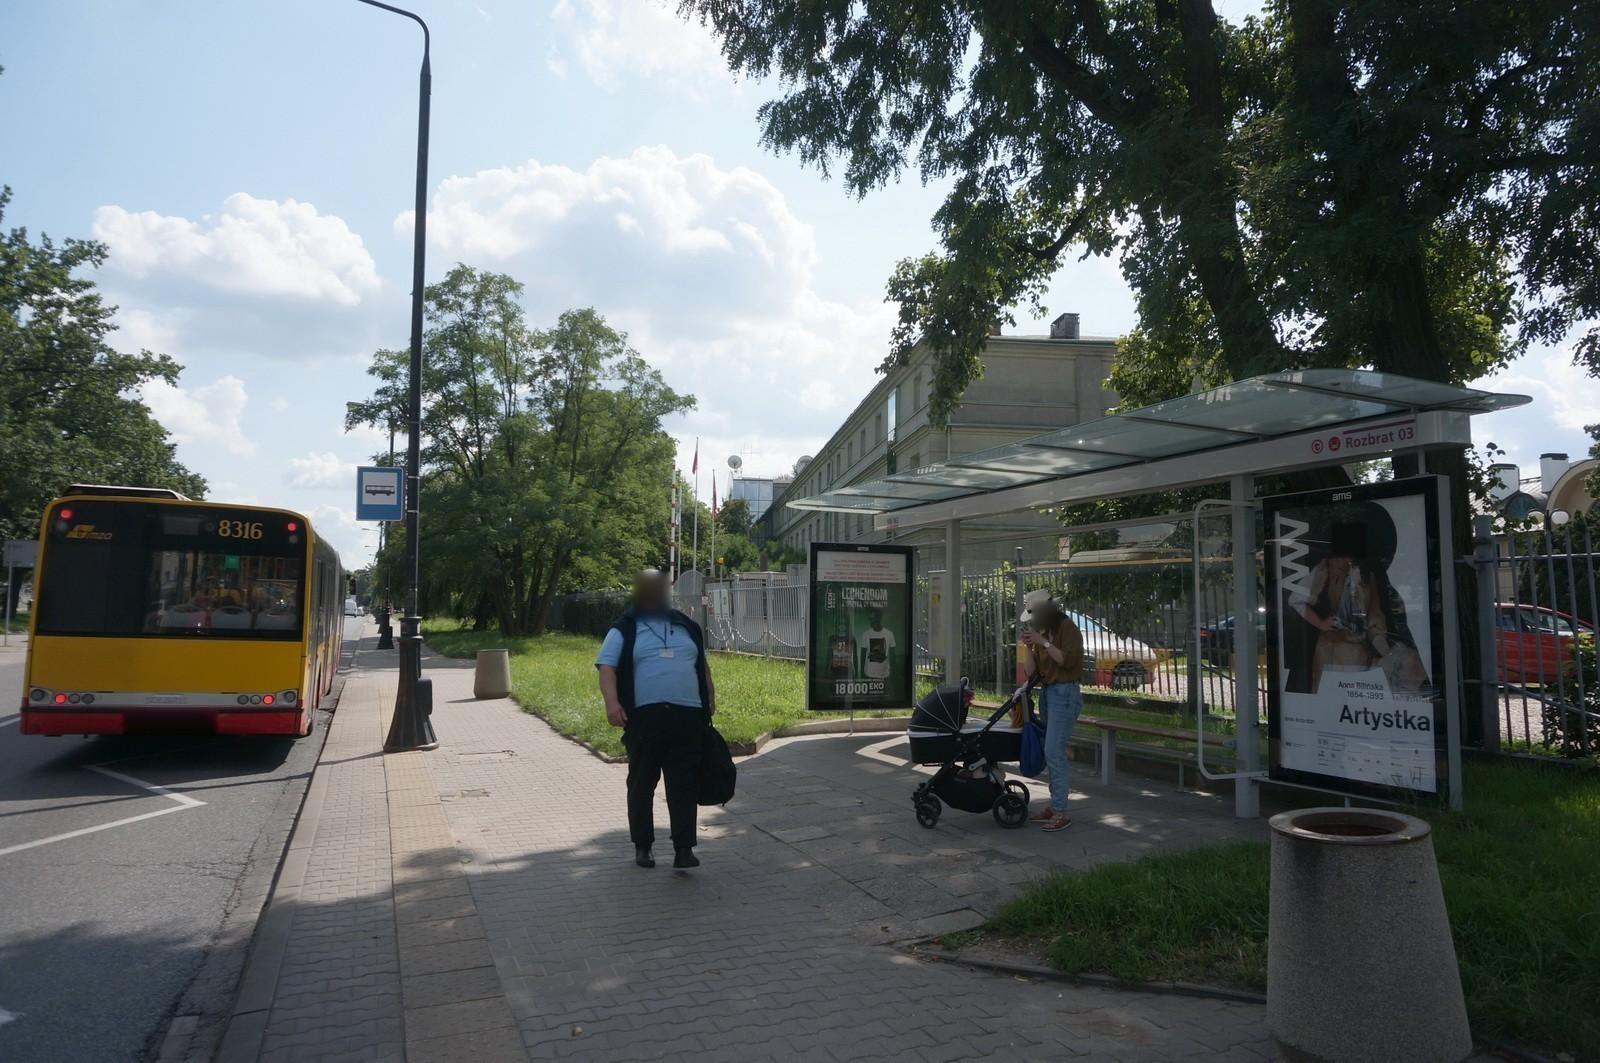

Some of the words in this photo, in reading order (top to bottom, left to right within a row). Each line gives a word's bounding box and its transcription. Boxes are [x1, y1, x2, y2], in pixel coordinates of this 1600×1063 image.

[1345, 431, 1394, 449] Rozbrat
[1398, 427, 1414, 440] 03
[1332, 491, 1352, 501] ams
[218, 519, 264, 540] 8316
[869, 682, 885, 690] EKO
[1338, 681, 1355, 689] Anna
[1339, 704, 1431, 731] Artystka
